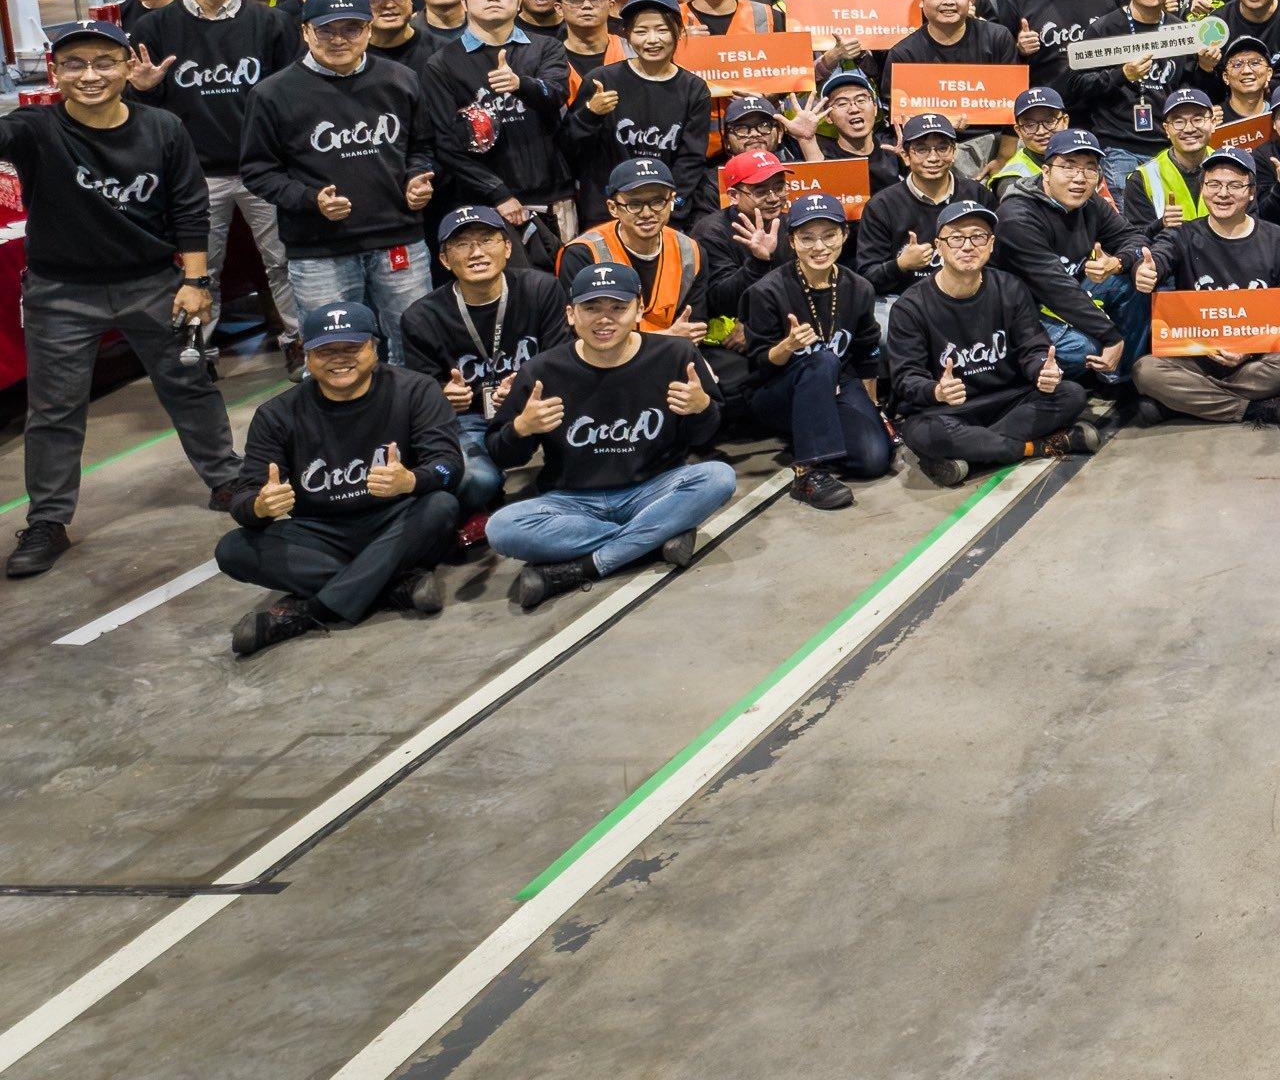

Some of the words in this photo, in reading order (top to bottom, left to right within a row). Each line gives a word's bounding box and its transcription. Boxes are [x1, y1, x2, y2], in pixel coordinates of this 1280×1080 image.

[832, 9, 878, 20] TESLA
[854, 24, 916, 36] Batteries
[1074, 36, 1196, 61] 加速世界向可持续能源的转变
[718, 50, 767, 63] TESLA
[743, 65, 808, 78] Batteries
[200, 87, 240, 96] SHANGHAI
[939, 80, 986, 92] TESLA
[900, 97, 907, 108] 5
[911, 96, 959, 108] Million
[962, 96, 1014, 108] Batterie
[1223, 130, 1264, 148] TESLA
[340, 148, 380, 159] SHANGHAI
[1200, 307, 1247, 319] TESLA
[1160, 328, 1168, 339] 5
[1171, 326, 1219, 339] Million
[593, 445, 636, 455] SHANGHAI
[329, 487, 371, 501] SHANGHA
